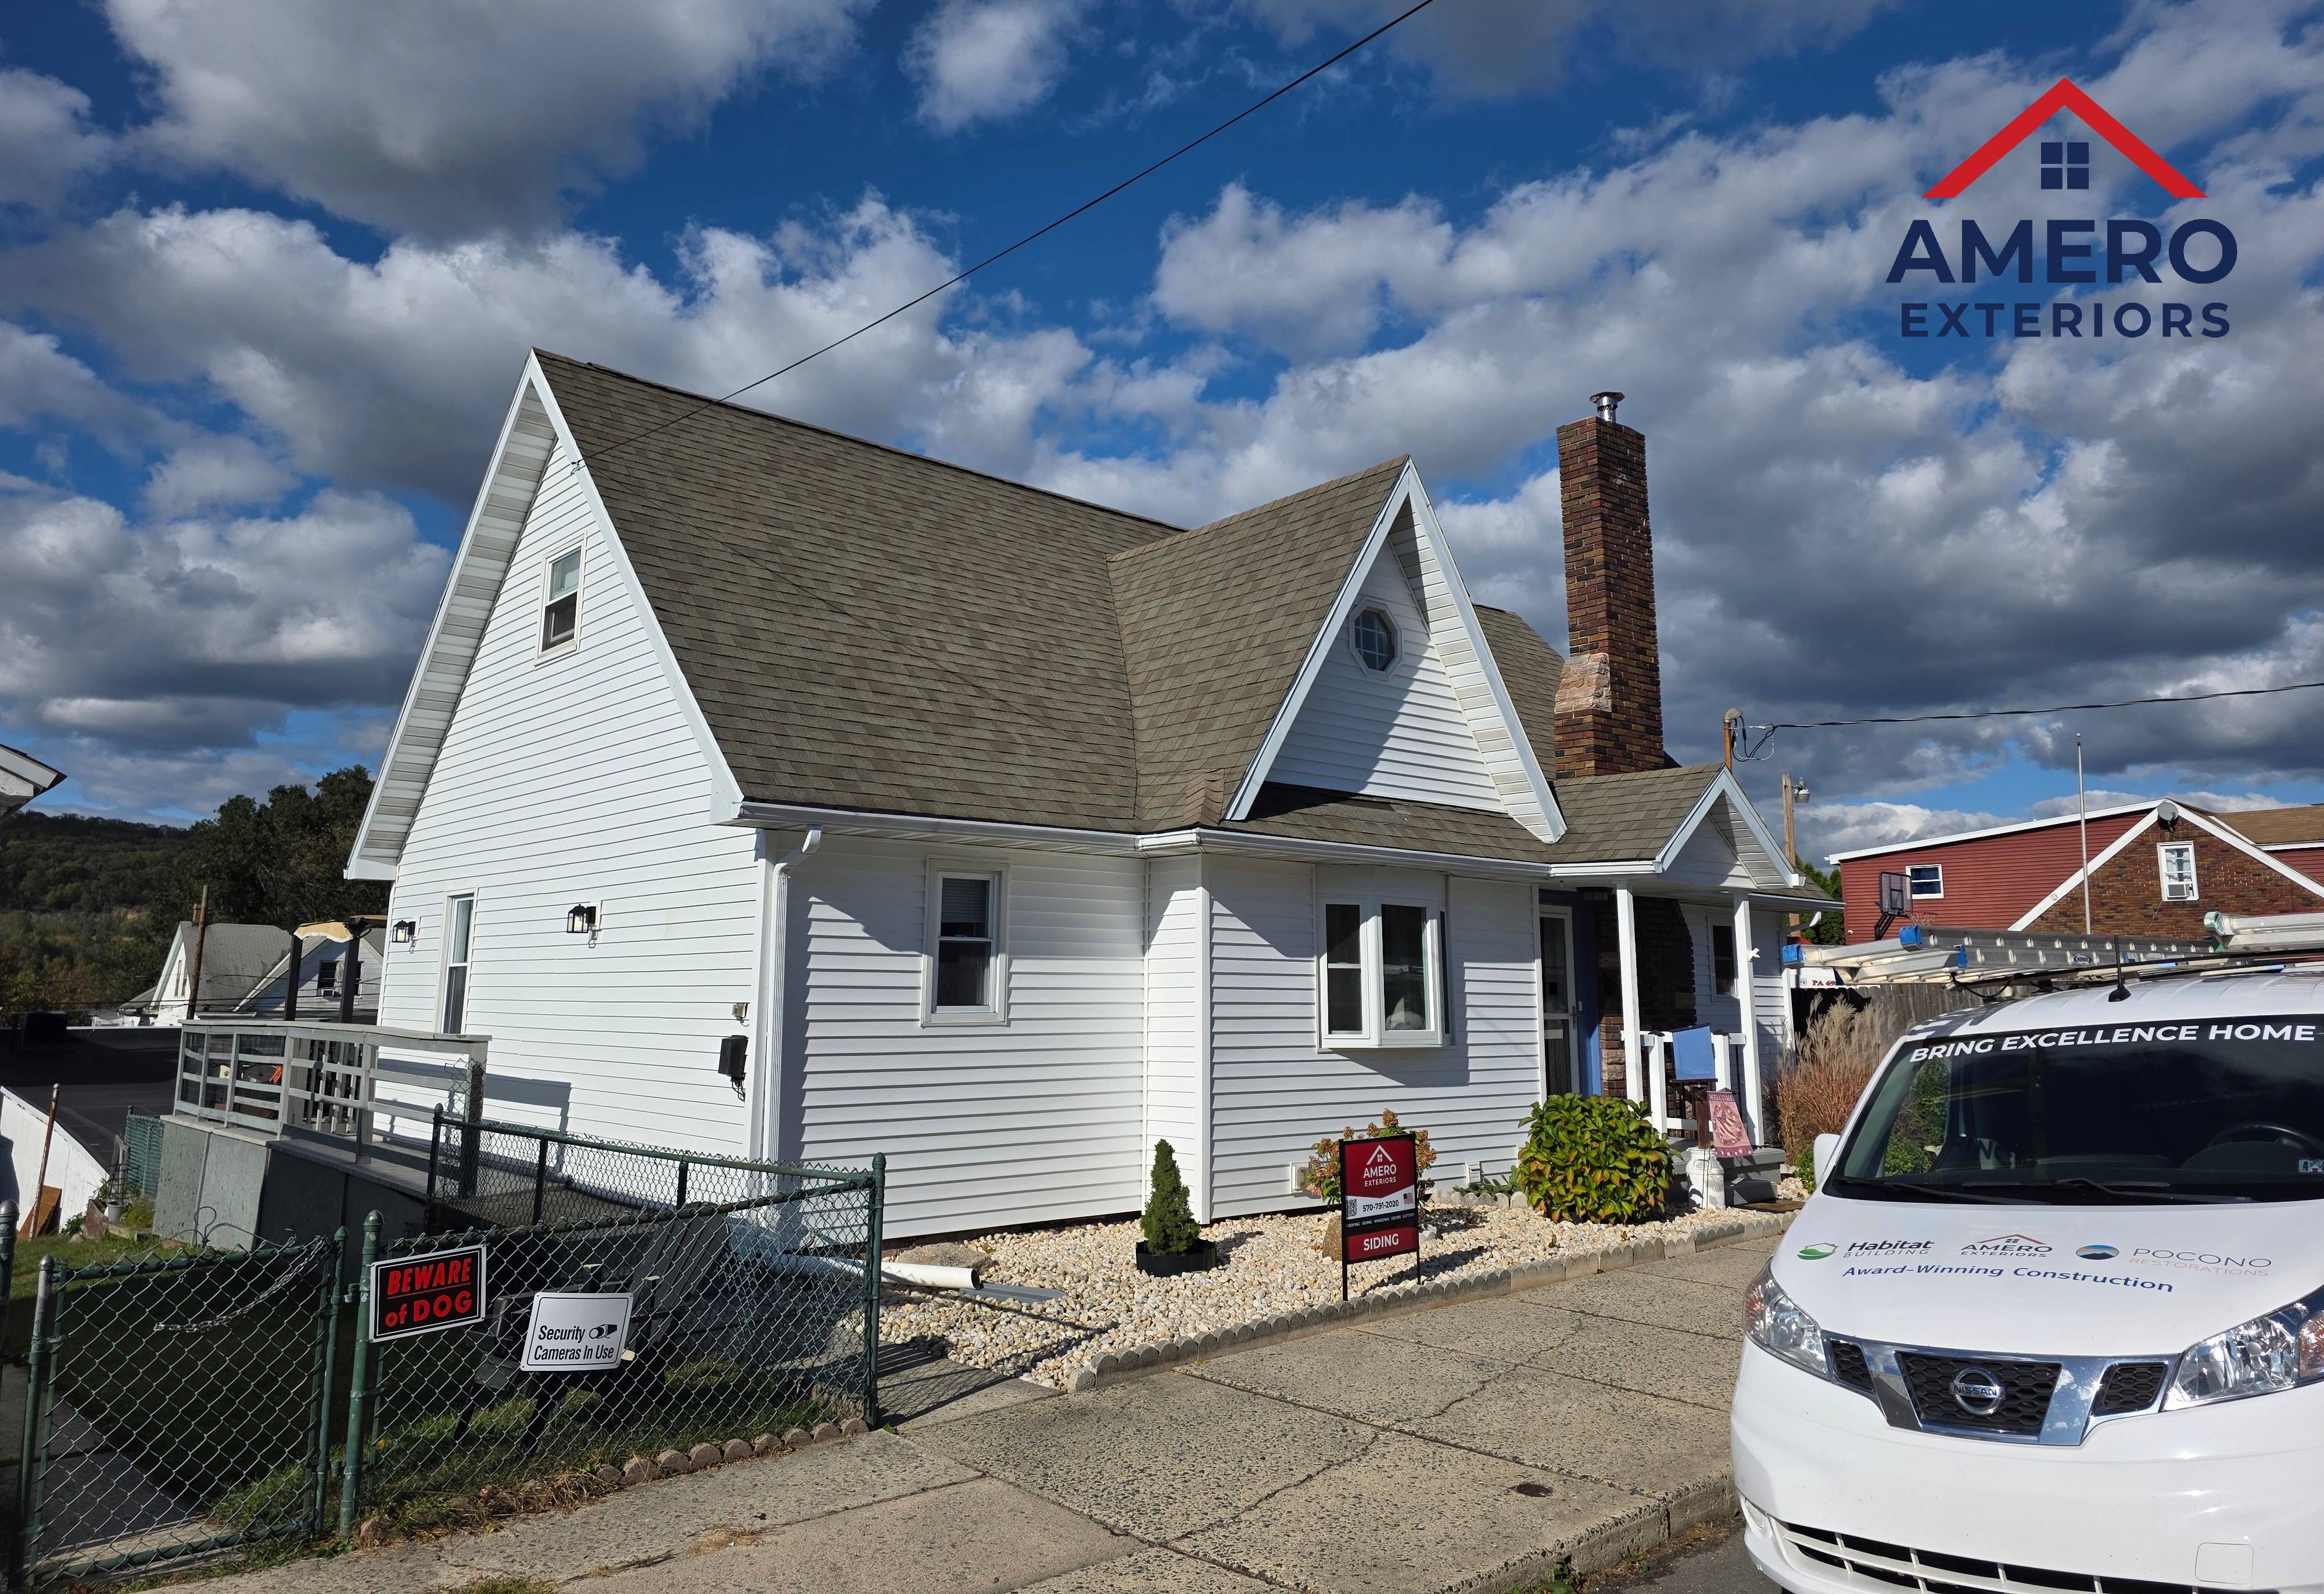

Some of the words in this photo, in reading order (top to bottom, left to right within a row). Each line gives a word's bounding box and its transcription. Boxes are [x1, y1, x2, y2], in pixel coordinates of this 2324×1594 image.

[1910, 1039, 1995, 1062] BRING
[2001, 1025, 2199, 1051] EXCELLENCE
[2208, 1025, 2316, 1041] HOME
[1363, 1163, 1397, 1179] AMERO
[1365, 1176, 1396, 1187] EXTERIORS
[1362, 1199, 1399, 1212] 570-791-2020
[1364, 1233, 1399, 1251] SIDING
[1848, 1240, 1935, 1251] Habitat
[1960, 1244, 2053, 1253] AMERO
[1843, 1249, 1930, 1259] BUILDING
[2133, 1248, 2272, 1268] POCONO
[2129, 1258, 2269, 1277] RESTORATIONS
[387, 1258, 472, 1295] BEWARE
[1842, 1265, 2003, 1277] Award-Winning
[2013, 1267, 2173, 1293] Construction
[385, 1303, 407, 1327] of
[413, 1291, 472, 1322] DOG
[538, 1325, 586, 1343] Security
[534, 1345, 582, 1360] Cameras
[583, 1345, 593, 1360] In
[595, 1345, 614, 1359] Use
[1954, 1385, 1997, 1396] NISSAN
